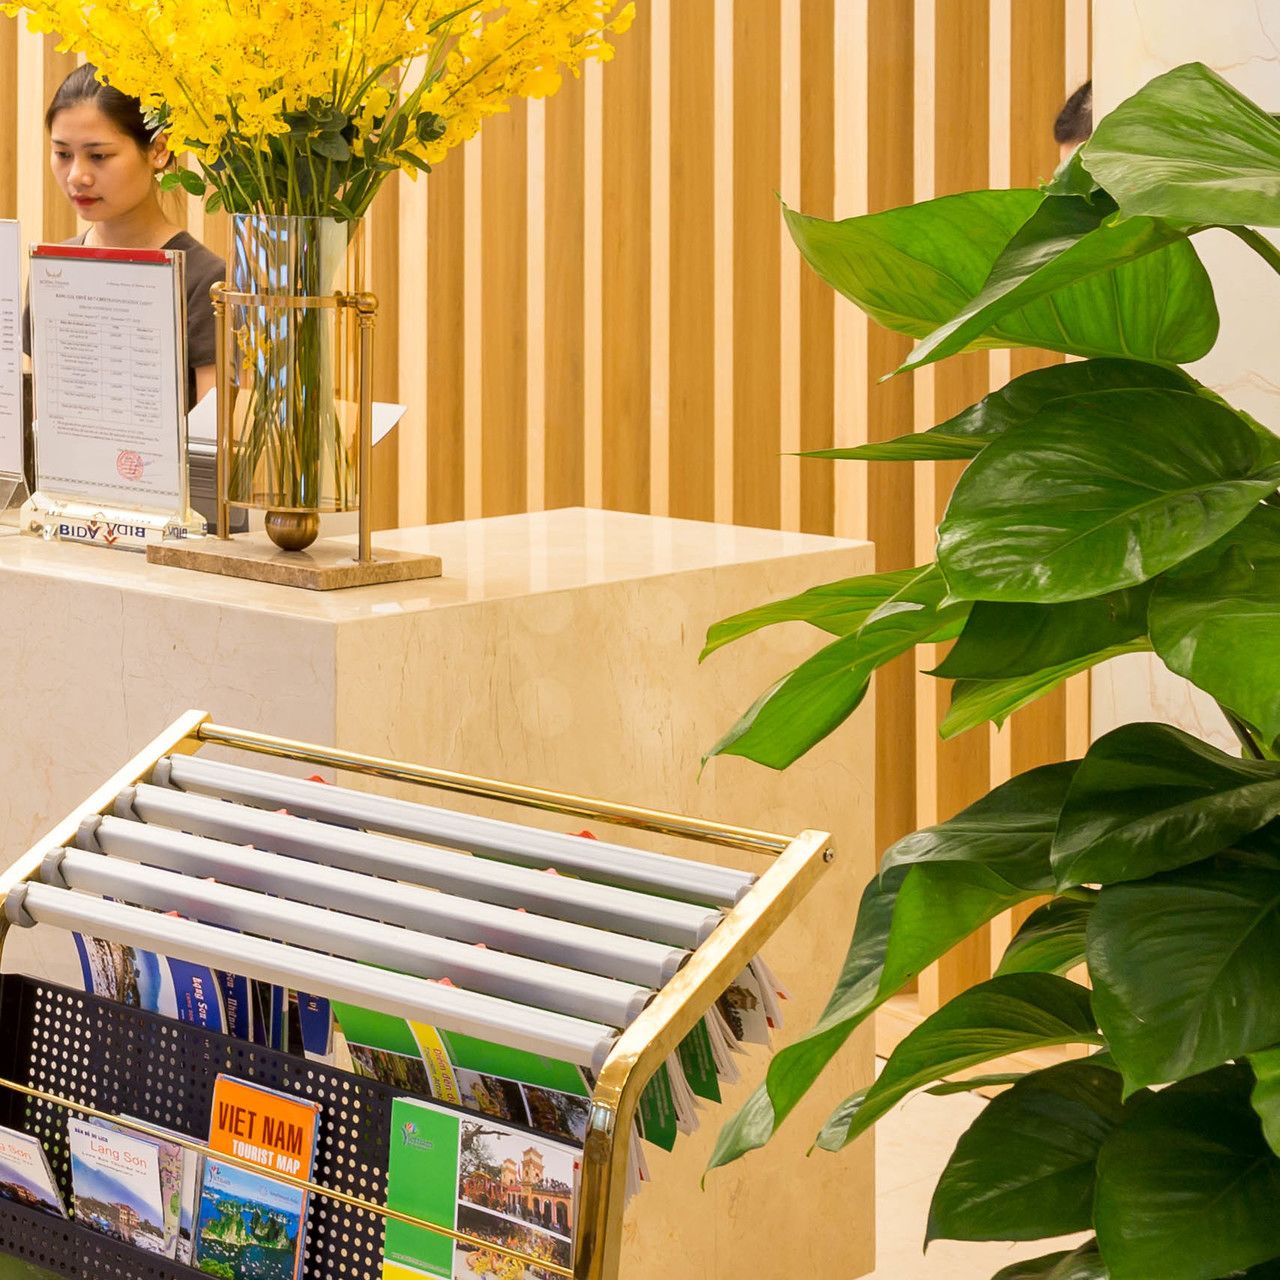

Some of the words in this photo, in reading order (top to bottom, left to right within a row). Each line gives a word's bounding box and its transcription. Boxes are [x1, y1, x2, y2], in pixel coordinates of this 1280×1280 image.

[218, 1101, 257, 1140] VIET
[261, 1115, 304, 1156] NAM
[232, 1139, 274, 1167] TOURIST
[276, 1154, 301, 1174] MAP
